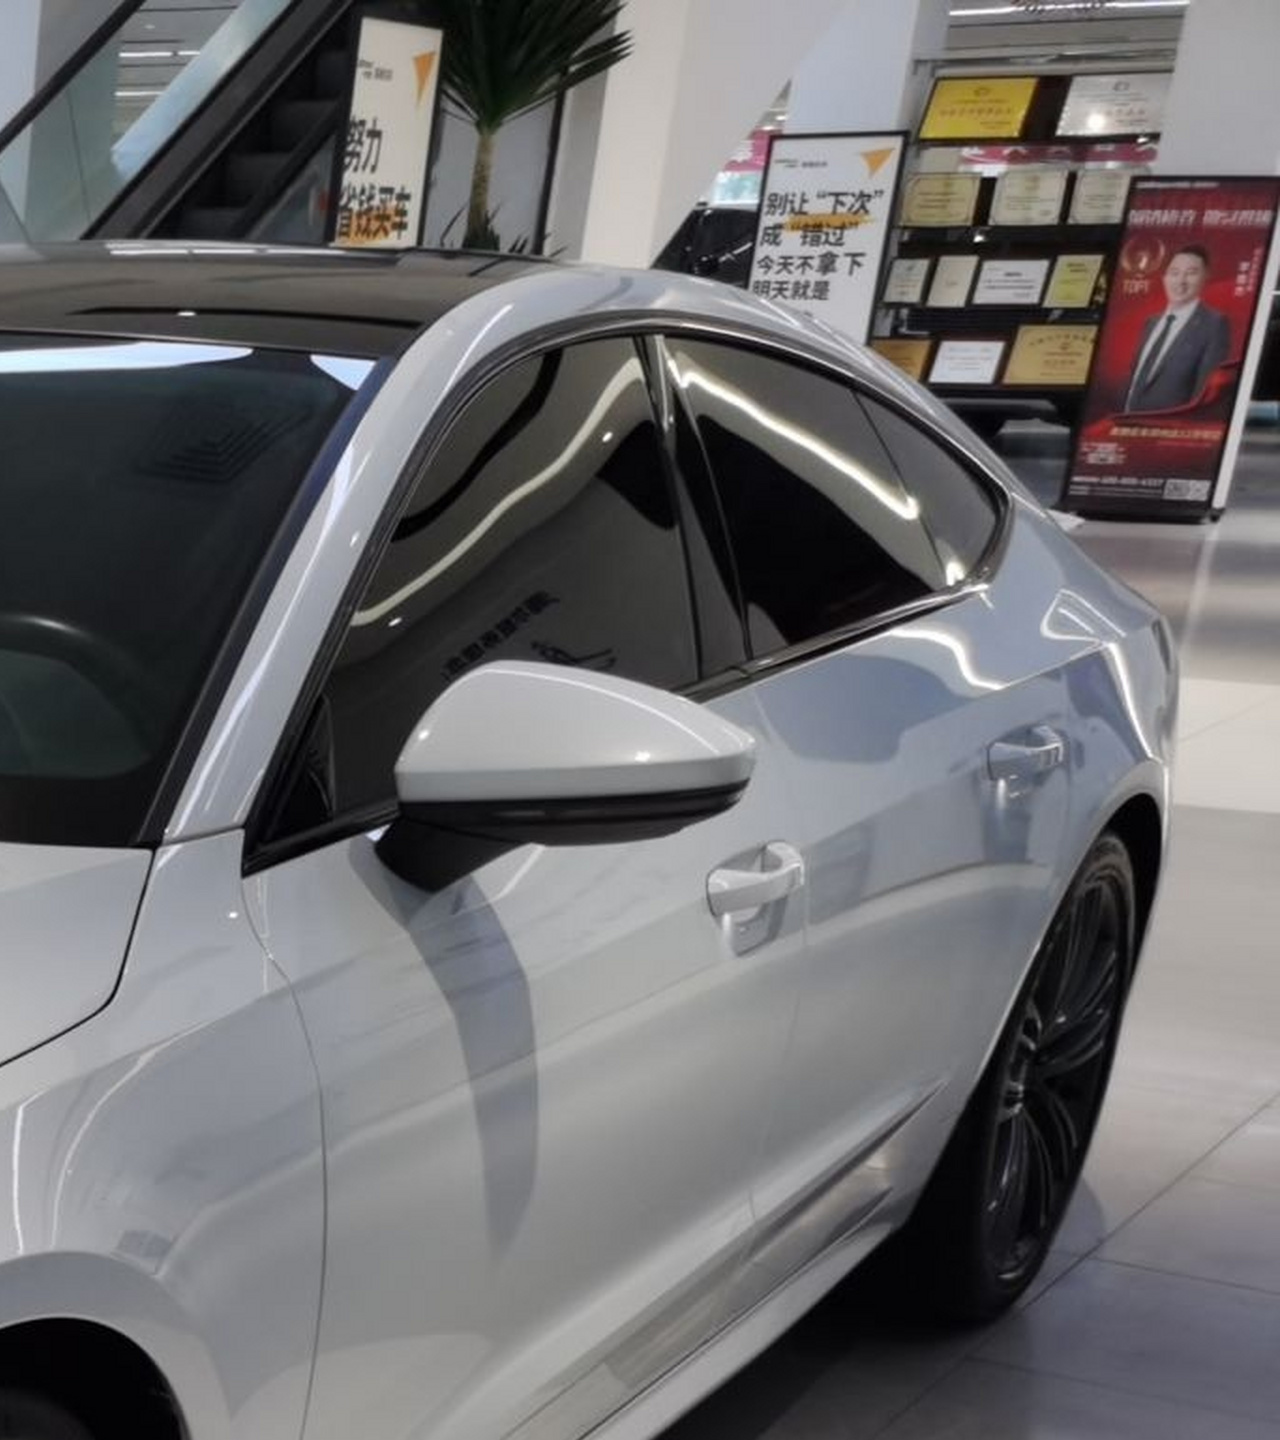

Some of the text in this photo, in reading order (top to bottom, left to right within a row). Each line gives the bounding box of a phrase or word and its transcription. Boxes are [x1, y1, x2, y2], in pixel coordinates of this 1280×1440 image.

[756, 252, 867, 276] 今天不拿下
[752, 280, 831, 301] 明天就是
